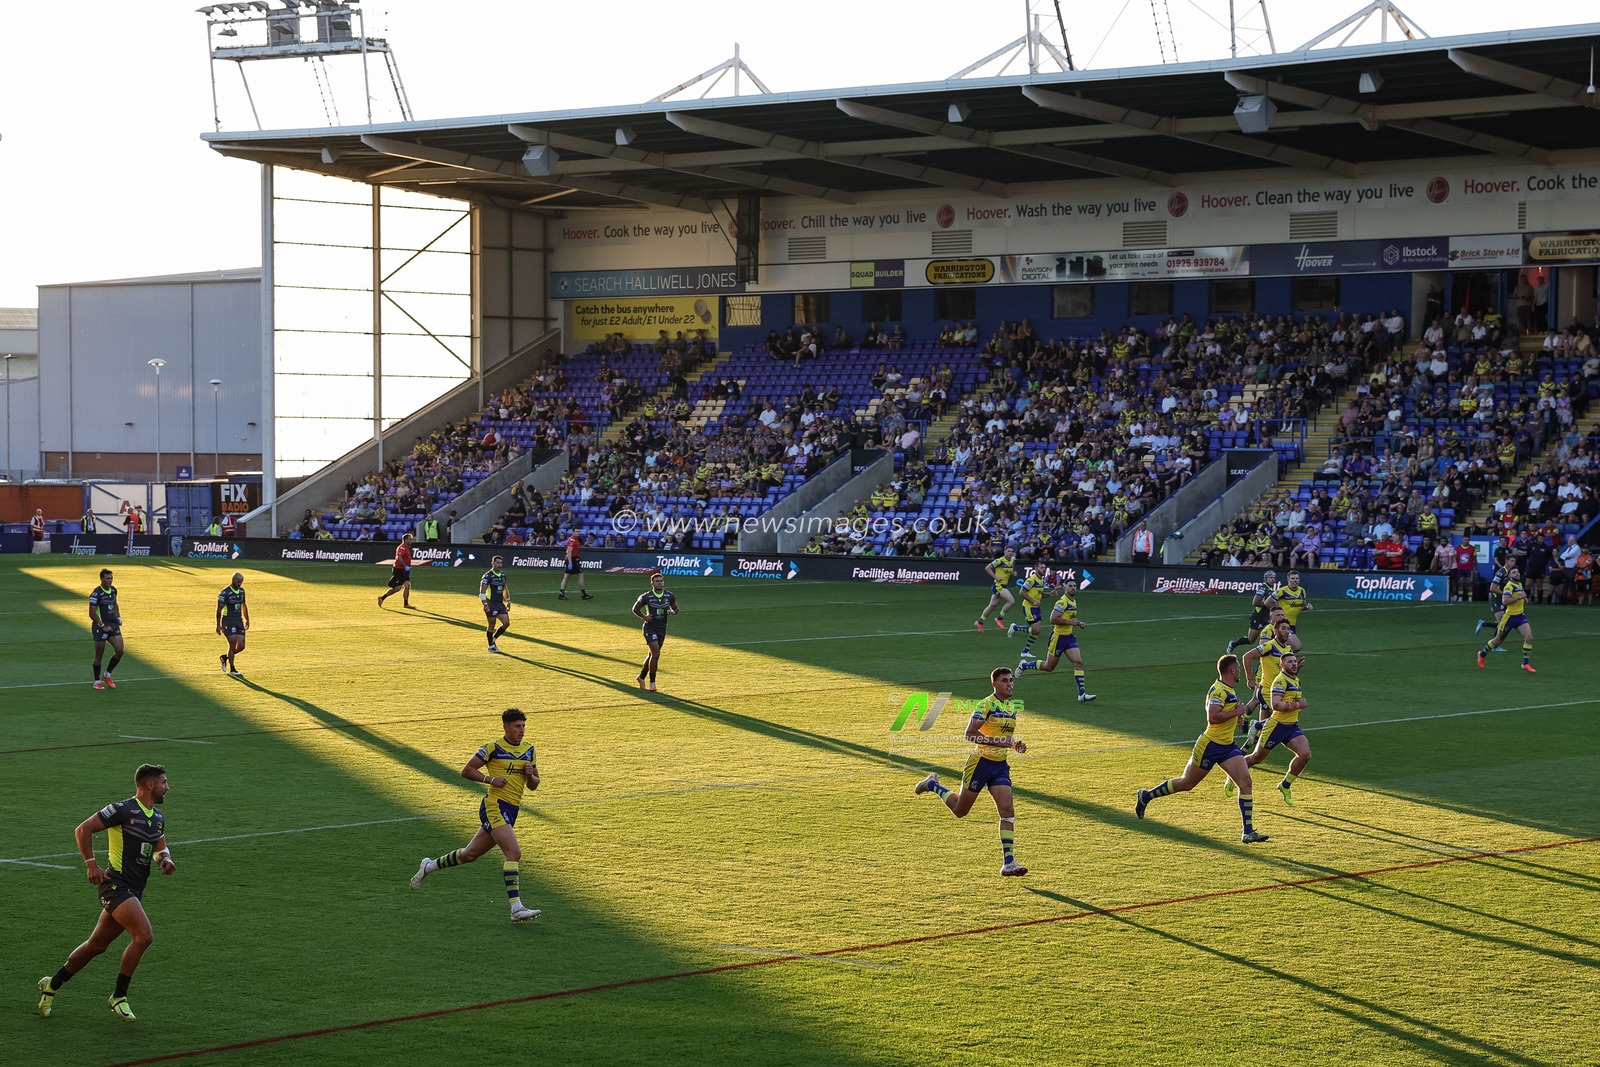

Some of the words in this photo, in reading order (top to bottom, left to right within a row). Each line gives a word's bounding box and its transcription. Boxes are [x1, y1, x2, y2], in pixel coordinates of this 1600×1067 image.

[1464, 179, 1520, 194] Hoover.
[1527, 174, 1565, 191] Cook
[1571, 173, 1598, 189] the
[1201, 194, 1251, 209] Hoover.
[1255, 191, 1292, 206] Clean
[1296, 188, 1320, 204] the
[1323, 189, 1352, 205] way
[1356, 187, 1383, 203] you
[1388, 183, 1414, 198] live
[967, 206, 1011, 220] Hoover.
[1016, 203, 1047, 218] Wash
[1051, 202, 1073, 216] the
[1077, 204, 1102, 217] way
[1106, 201, 1129, 216] you
[1134, 197, 1156, 212] live
[801, 215, 826, 229] Chill
[829, 214, 849, 227] the
[853, 215, 876, 229] way
[879, 213, 900, 228] you
[906, 210, 927, 223] live
[563, 228, 600, 240] Hoover.
[604, 225, 630, 238] Cook
[633, 224, 651, 237] the
[654, 225, 675, 238] way
[678, 224, 697, 238] you
[701, 221, 720, 233] live
[1109, 252, 1120, 260] Let
[1128, 251, 1142, 260] take
[1402, 245, 1438, 257] Ibstock
[1459, 249, 1481, 257] Brick
[1482, 248, 1504, 257] Store
[1506, 247, 1521, 256] Ltd
[933, 263, 987, 273] WARRINGTON
[1109, 261, 1123, 270] your
[1124, 260, 1139, 269] print
[1166, 259, 1191, 268] 01925
[1193, 258, 1225, 267] 939784
[851, 270, 874, 279] SQUAD
[875, 269, 904, 278] BUILDER
[933, 271, 987, 280] FABRICATIONS
[1021, 273, 1052, 281] DIGITAL
[574, 277, 621, 292] SEARCH
[626, 274, 694, 290] HALLIWELL
[695, 272, 737, 289] JONES
[575, 304, 599, 315] Catch
[600, 304, 616, 314] the
[616, 304, 631, 314] bus
[632, 302, 675, 315] anywhere
[581, 315, 592, 327] for
[592, 316, 607, 328] just
[609, 315, 620, 325] £2
[621, 314, 657, 326] Adult/£1
[658, 314, 683, 325] Under
[683, 313, 695, 325] 22
[220, 483, 248, 502] FIX
[221, 502, 249, 512] RADIO
[193, 541, 230, 554] TopMark
[412, 548, 452, 560] TopMark
[187, 550, 228, 560] Solutions
[281, 548, 315, 559] Facilities
[315, 550, 364, 562] Management
[512, 556, 549, 568] Facilities
[656, 555, 701, 569] TopMark
[737, 558, 784, 573] TopMark
[730, 569, 783, 579] Solutions
[852, 567, 896, 579] Facilities
[897, 568, 961, 581] Management
[1023, 566, 1076, 580] ToMark
[1155, 577, 1206, 590] Facilities
[1354, 576, 1417, 592] TopMark
[1345, 588, 1414, 601] Solutions
